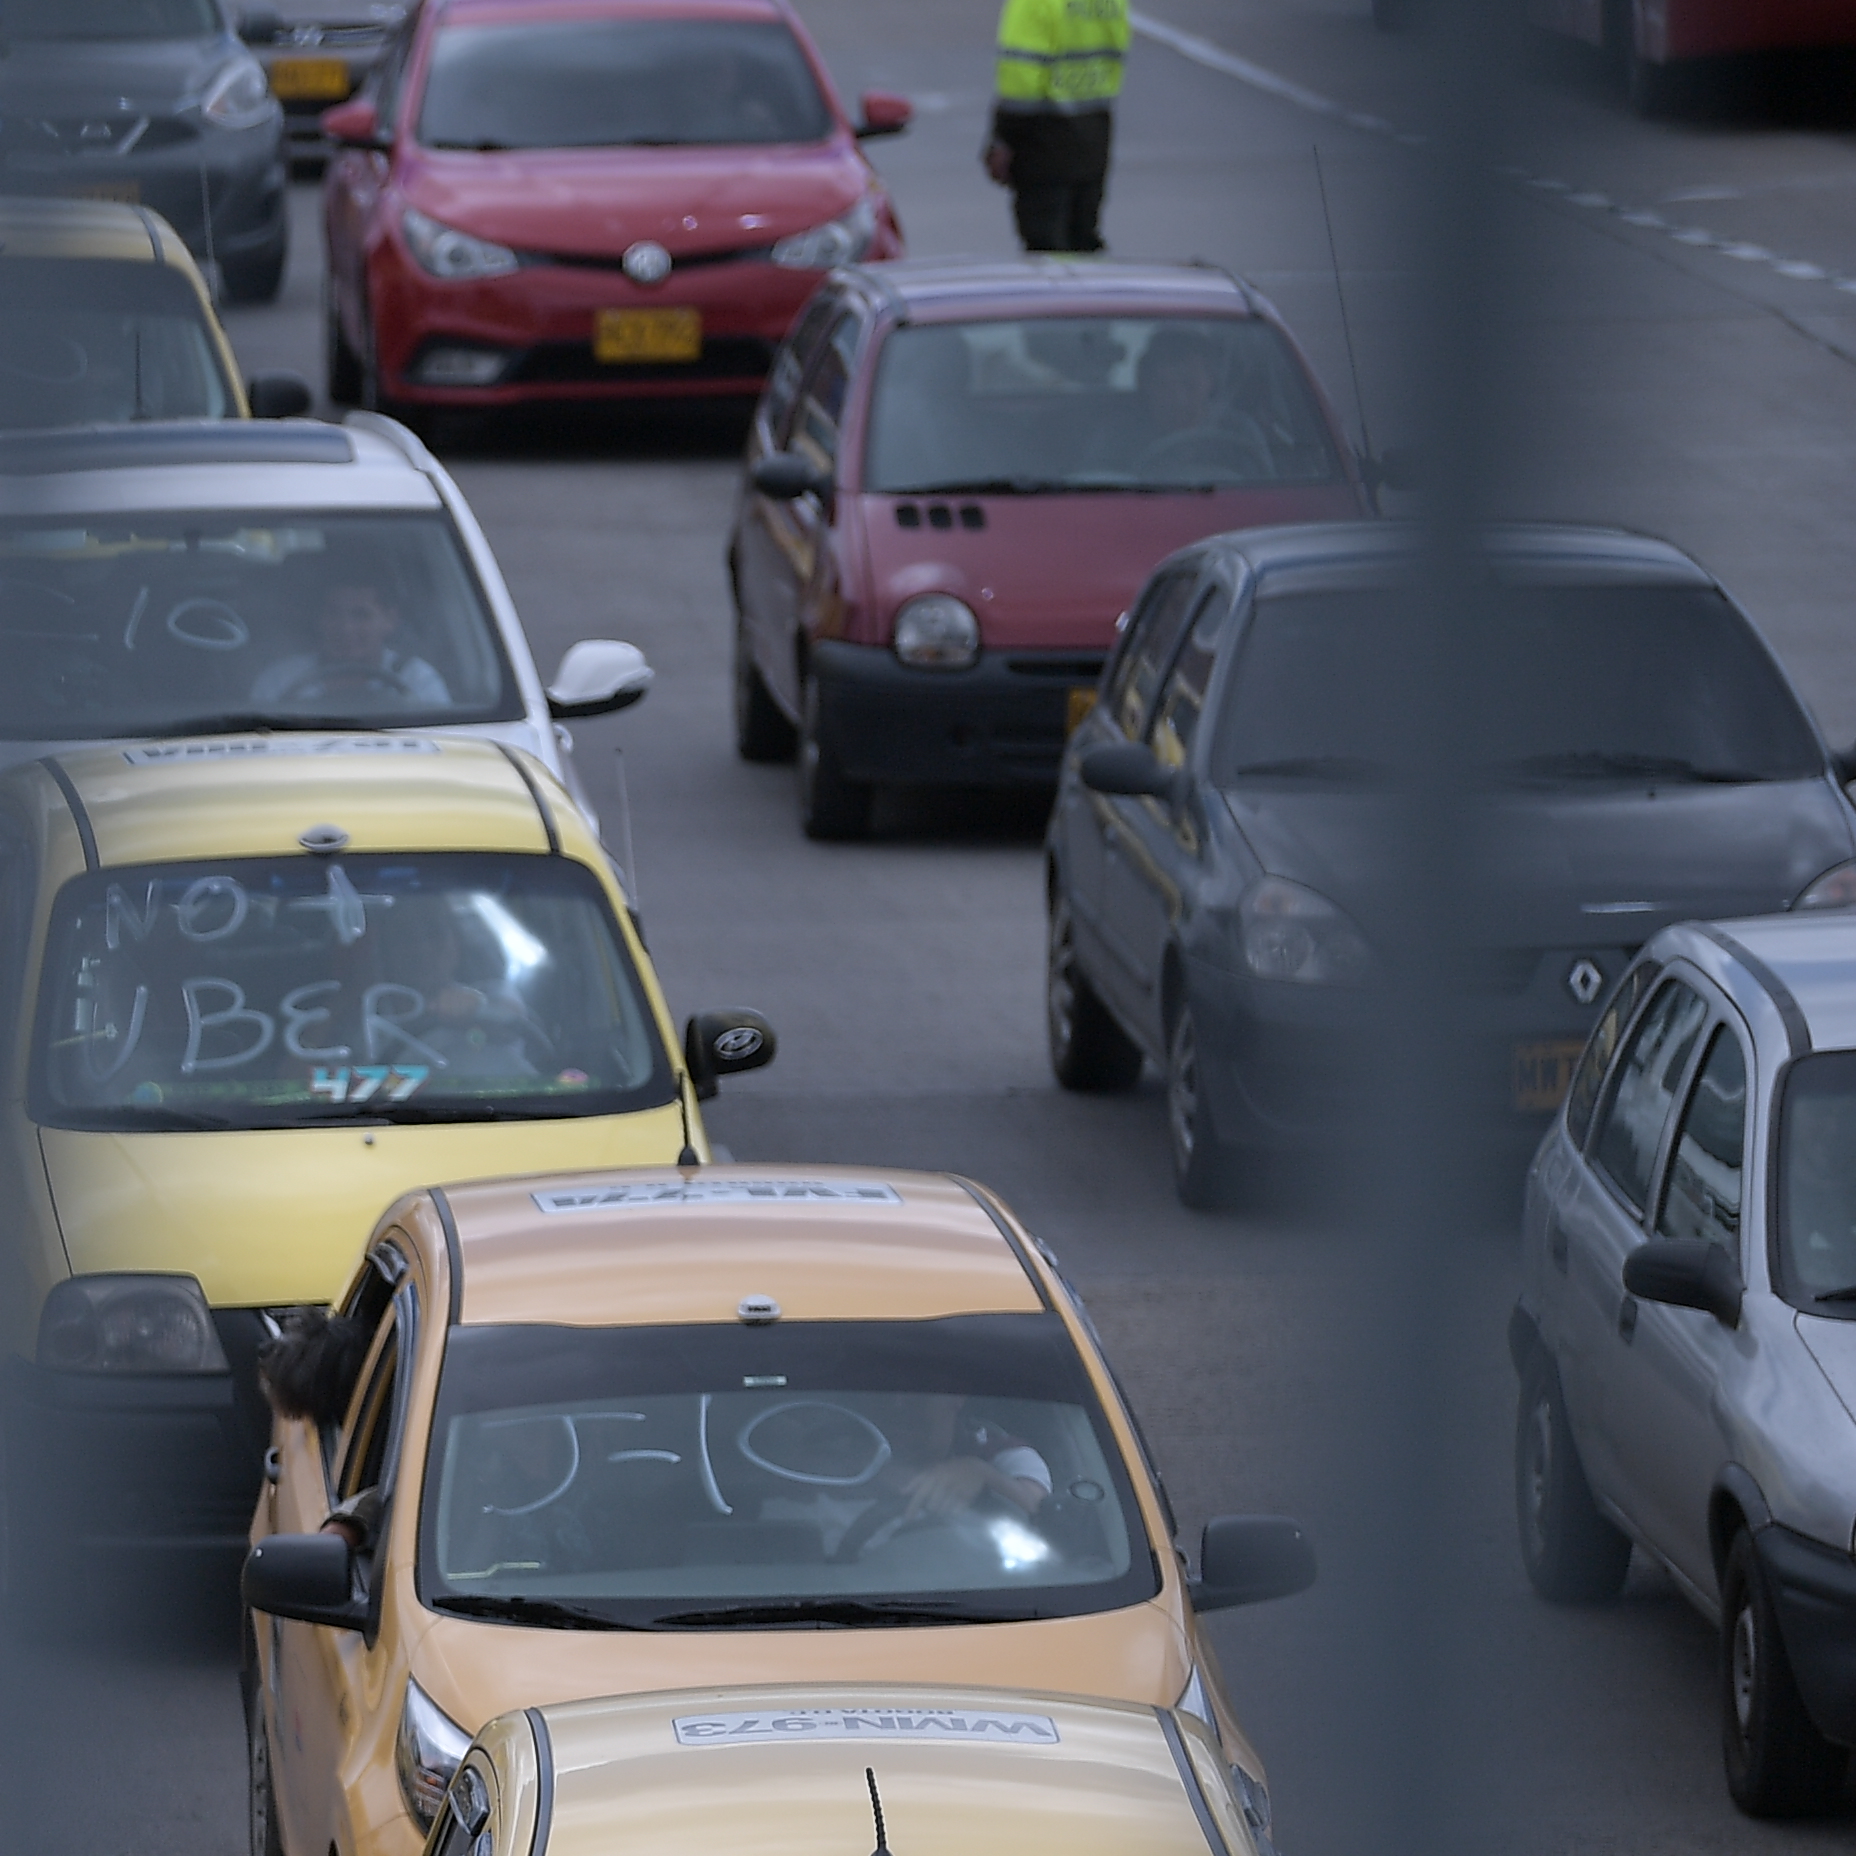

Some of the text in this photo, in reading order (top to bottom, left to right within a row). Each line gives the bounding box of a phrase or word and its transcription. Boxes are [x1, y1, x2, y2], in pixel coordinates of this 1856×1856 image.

[105, 876, 248, 949] NO
[90, 978, 449, 1084] UBER
[308, 1064, 431, 1102] 477
[681, 1717, 1053, 1737] WMN-973
